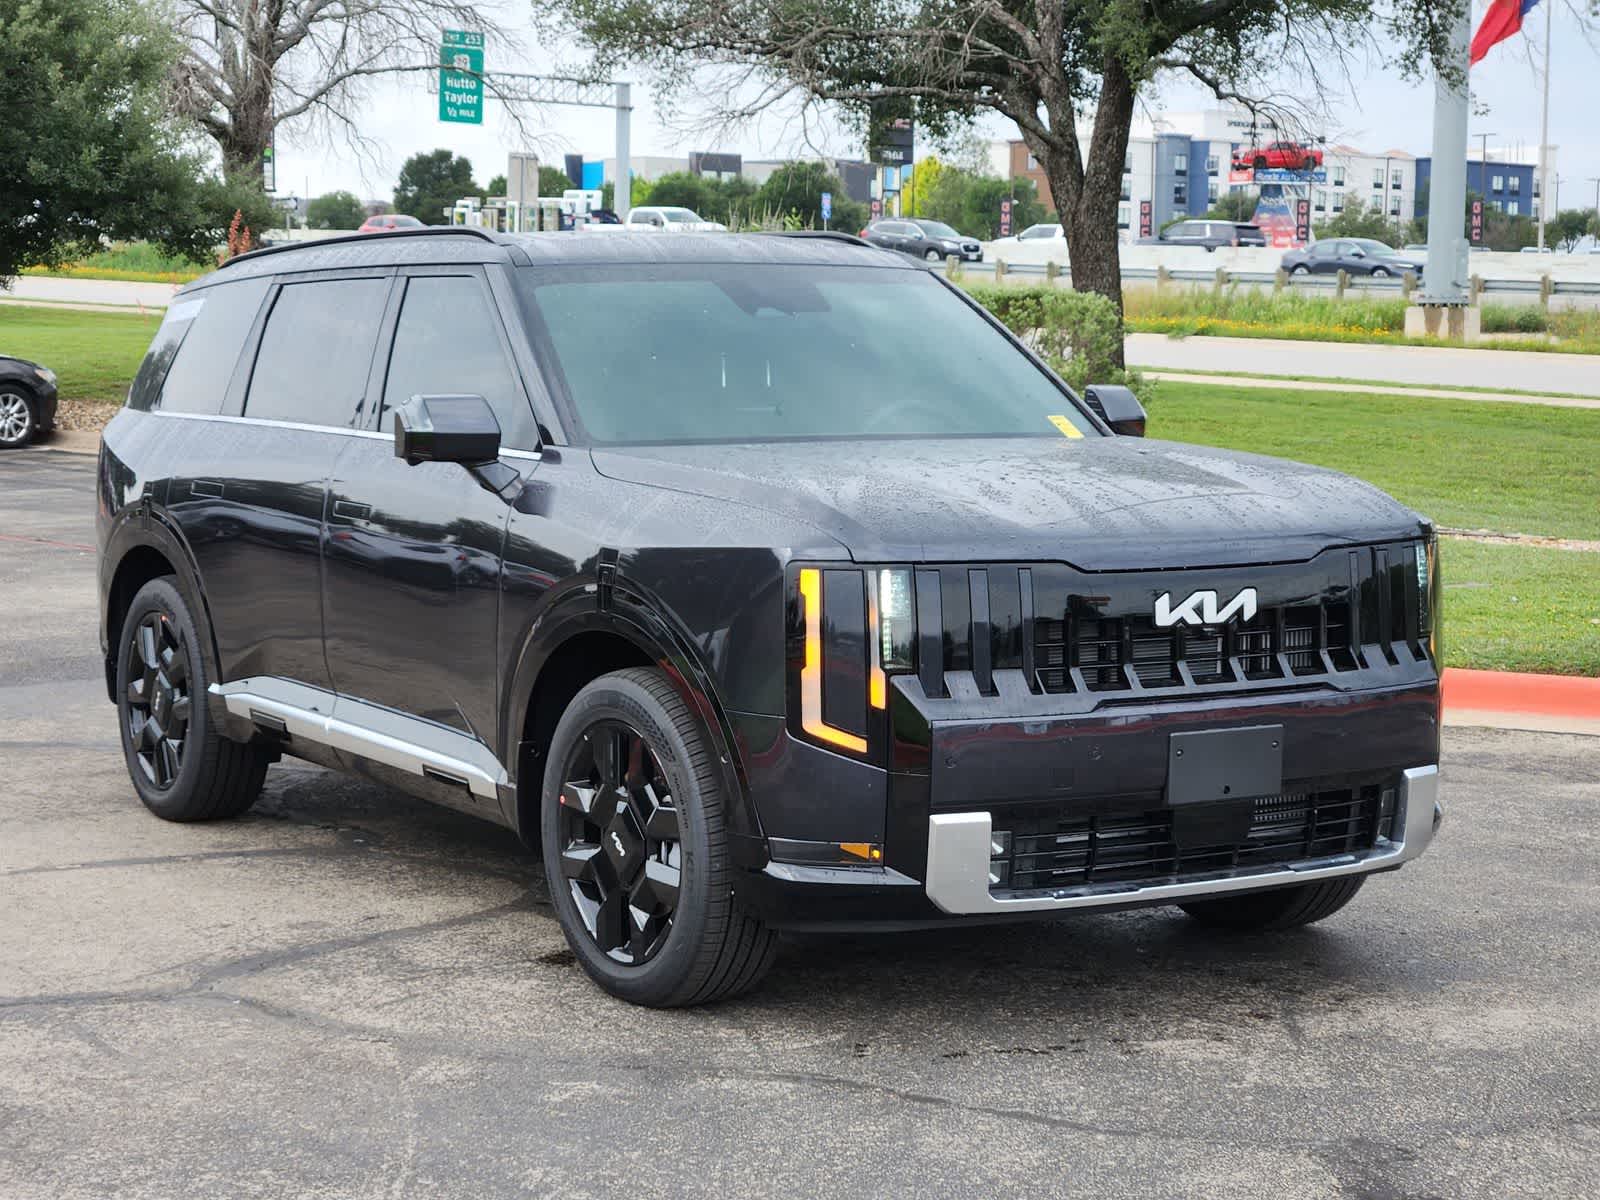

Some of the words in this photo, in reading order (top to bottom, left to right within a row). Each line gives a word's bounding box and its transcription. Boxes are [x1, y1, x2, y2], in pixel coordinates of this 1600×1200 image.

[444, 91, 479, 106] Taylor
[446, 76, 477, 90] Hutto
[1001, 201, 1010, 236] GMC
[1141, 203, 1150, 237] GMC
[1298, 201, 1308, 239] GMC
[1472, 201, 1481, 241] GMC
[1154, 588, 1257, 626] KIA
